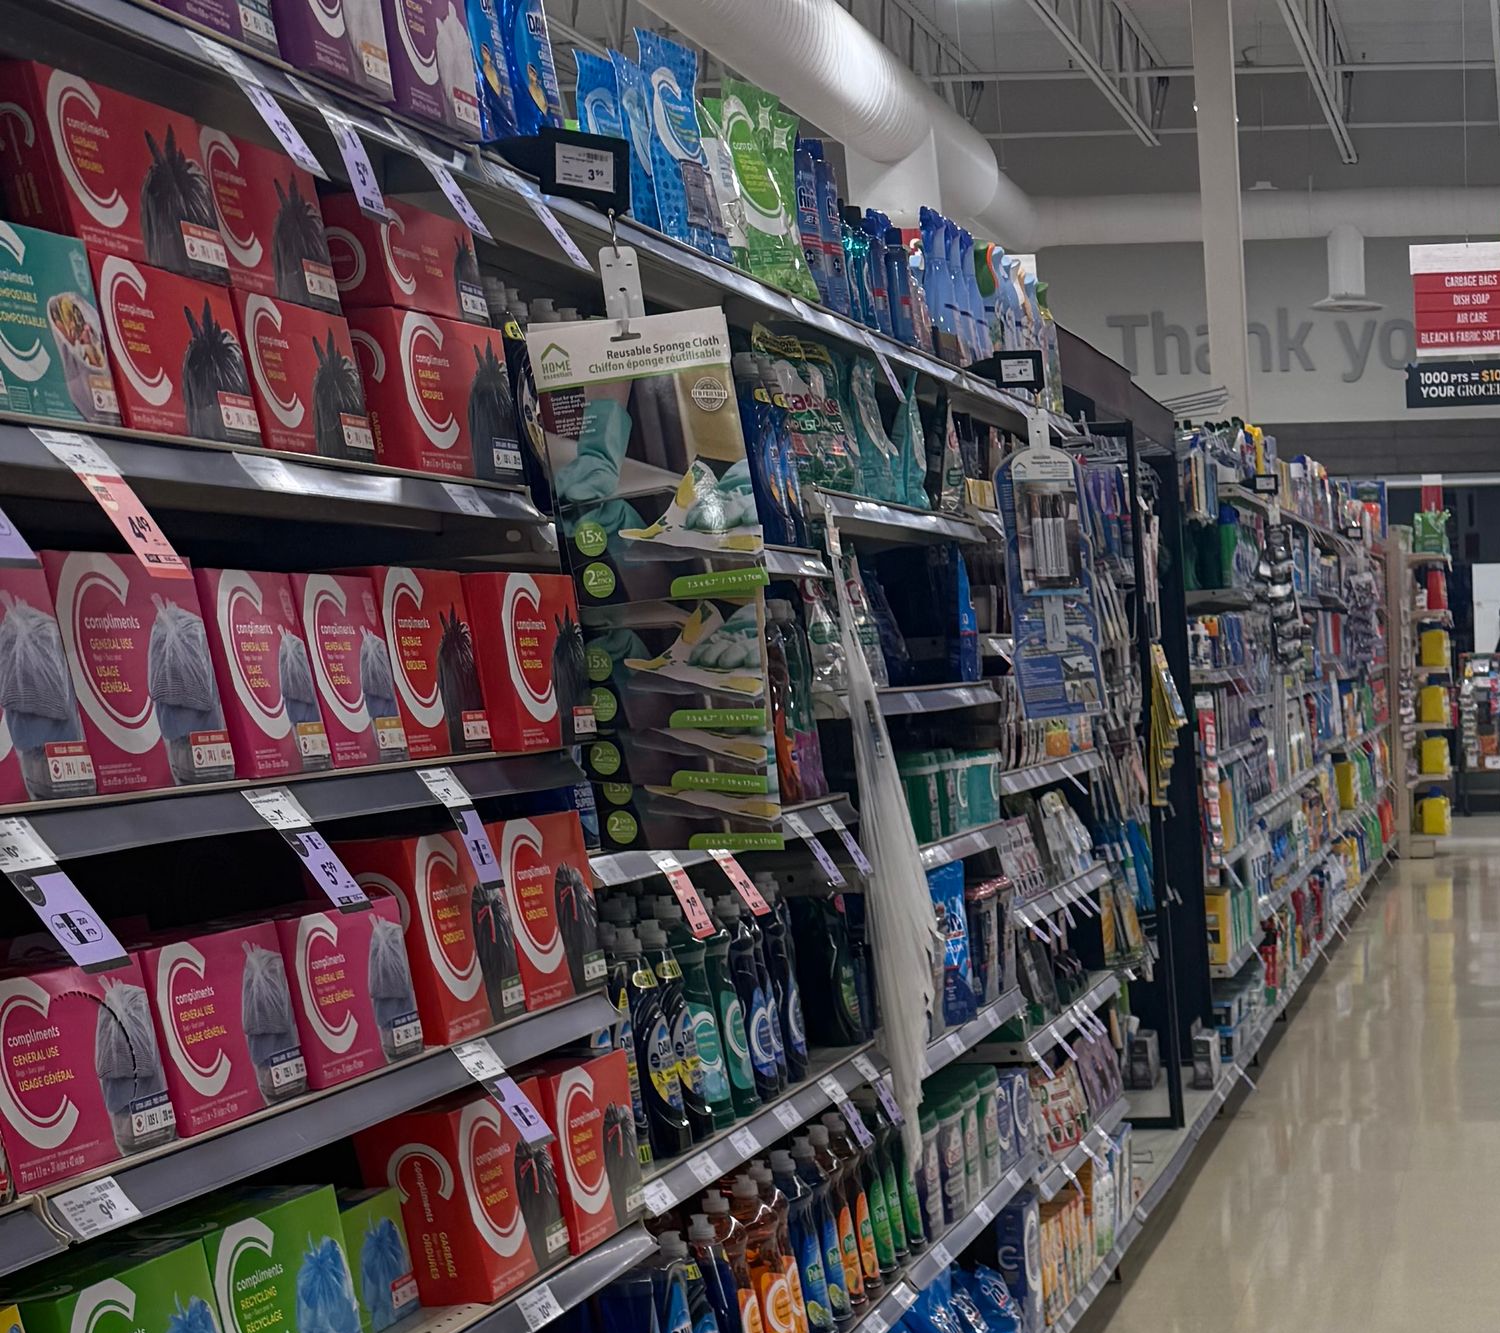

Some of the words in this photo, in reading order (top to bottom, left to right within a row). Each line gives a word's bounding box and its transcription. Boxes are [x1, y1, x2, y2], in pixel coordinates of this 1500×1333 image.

[1445, 275, 1477, 287] GARBAGE
[1479, 274, 1497, 286] BAGS
[1453, 295, 1470, 305] DISH
[1472, 294, 1490, 305] SOAP
[1457, 313, 1468, 324] AIR
[1469, 312, 1488, 323] CARE
[1421, 332, 1449, 343] BLEACH
[1456, 330, 1481, 342] FABRIC
[607, 343, 652, 360] Reusable
[653, 340, 691, 357] Sponge
[692, 336, 720, 349] Cloth
[415, 353, 450, 368] compliments
[541, 358, 572, 374] HOME
[589, 360, 624, 374] Chiffon
[627, 354, 663, 372] éponge
[665, 347, 722, 365] réutilisable
[1420, 371, 1449, 384] 1000
[1450, 372, 1469, 383] PTS
[1481, 369, 1500, 382] $10
[1421, 385, 1455, 398] YOUR
[128, 516, 152, 543] 449
[579, 529, 603, 545] 15x
[587, 569, 597, 585] 2
[84, 615, 140, 633] compliments
[89, 638, 120, 650] GENERAL
[121, 638, 134, 649] USE
[96, 665, 120, 677] USAGE
[319, 861, 339, 886] 599
[175, 986, 215, 1006] compliments
[204, 1004, 215, 1017] USE
[8, 1026, 60, 1047] compliments
[12, 1049, 46, 1067] GENERAL
[47, 1046, 60, 1060] USE
[19, 1075, 45, 1092] USAGE
[236, 1263, 284, 1292] compliments
[240, 1286, 277, 1311] RECYCLING
